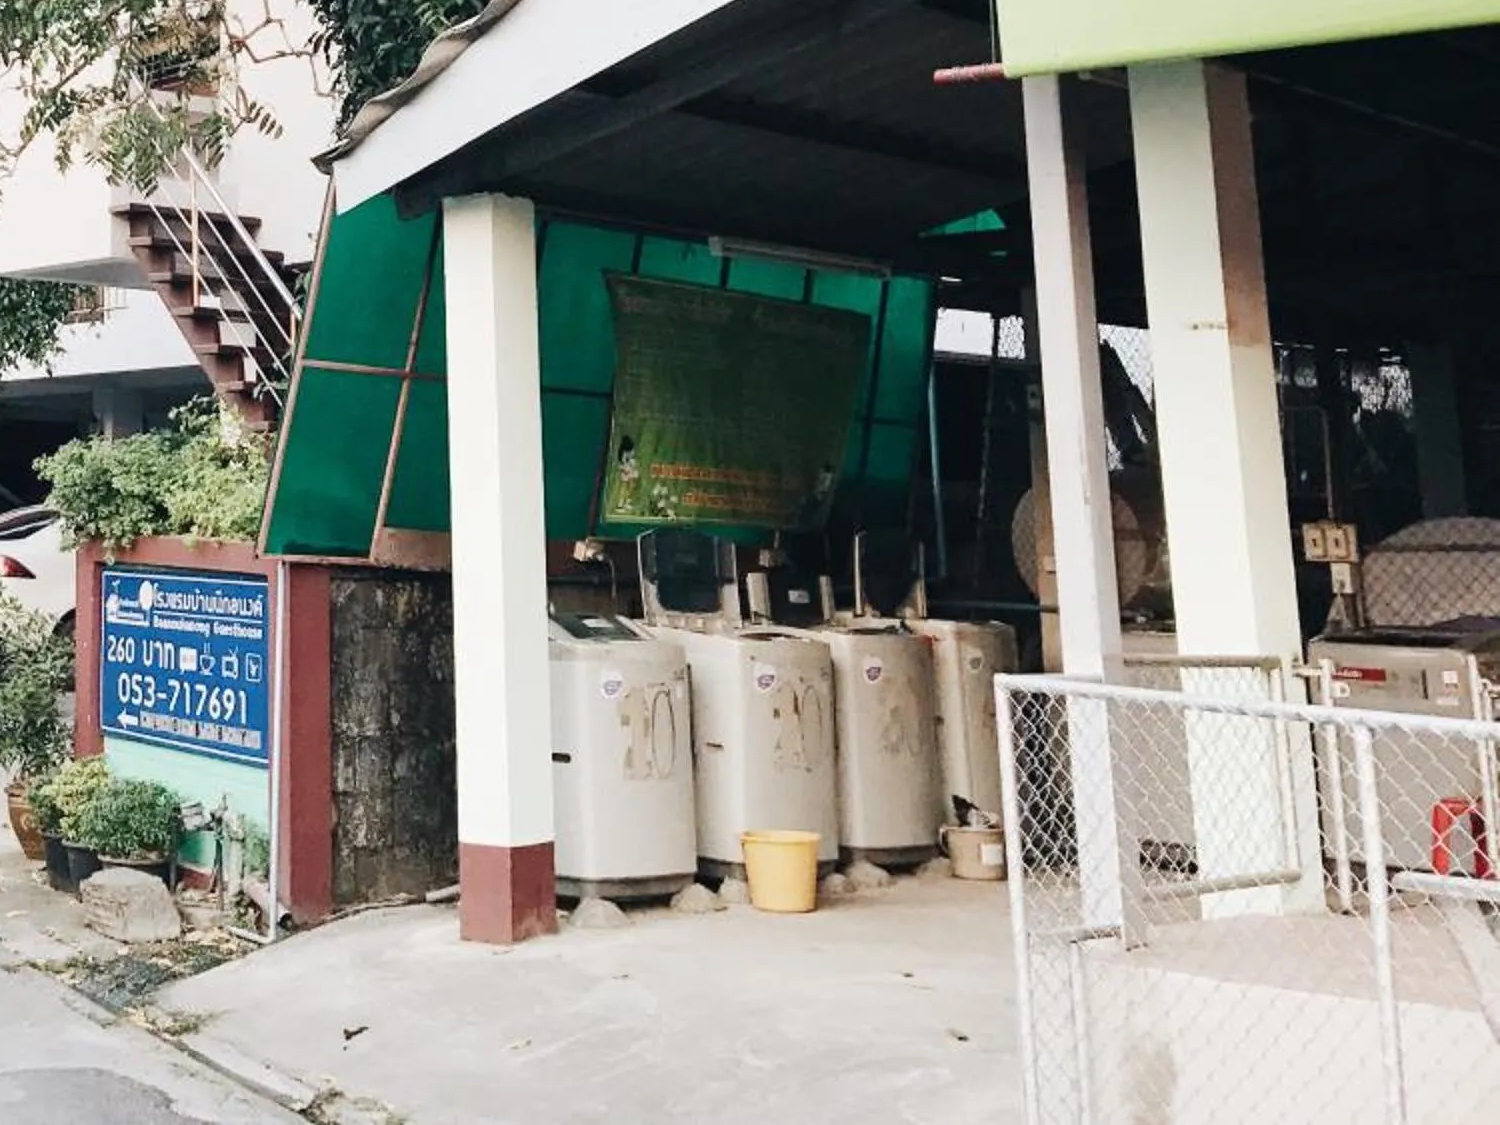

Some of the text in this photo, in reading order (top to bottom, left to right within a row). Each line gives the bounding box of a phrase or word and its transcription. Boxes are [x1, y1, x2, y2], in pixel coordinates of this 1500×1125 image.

[107, 634, 175, 670] 260 บาท
[117, 672, 247, 725] 053-717691
